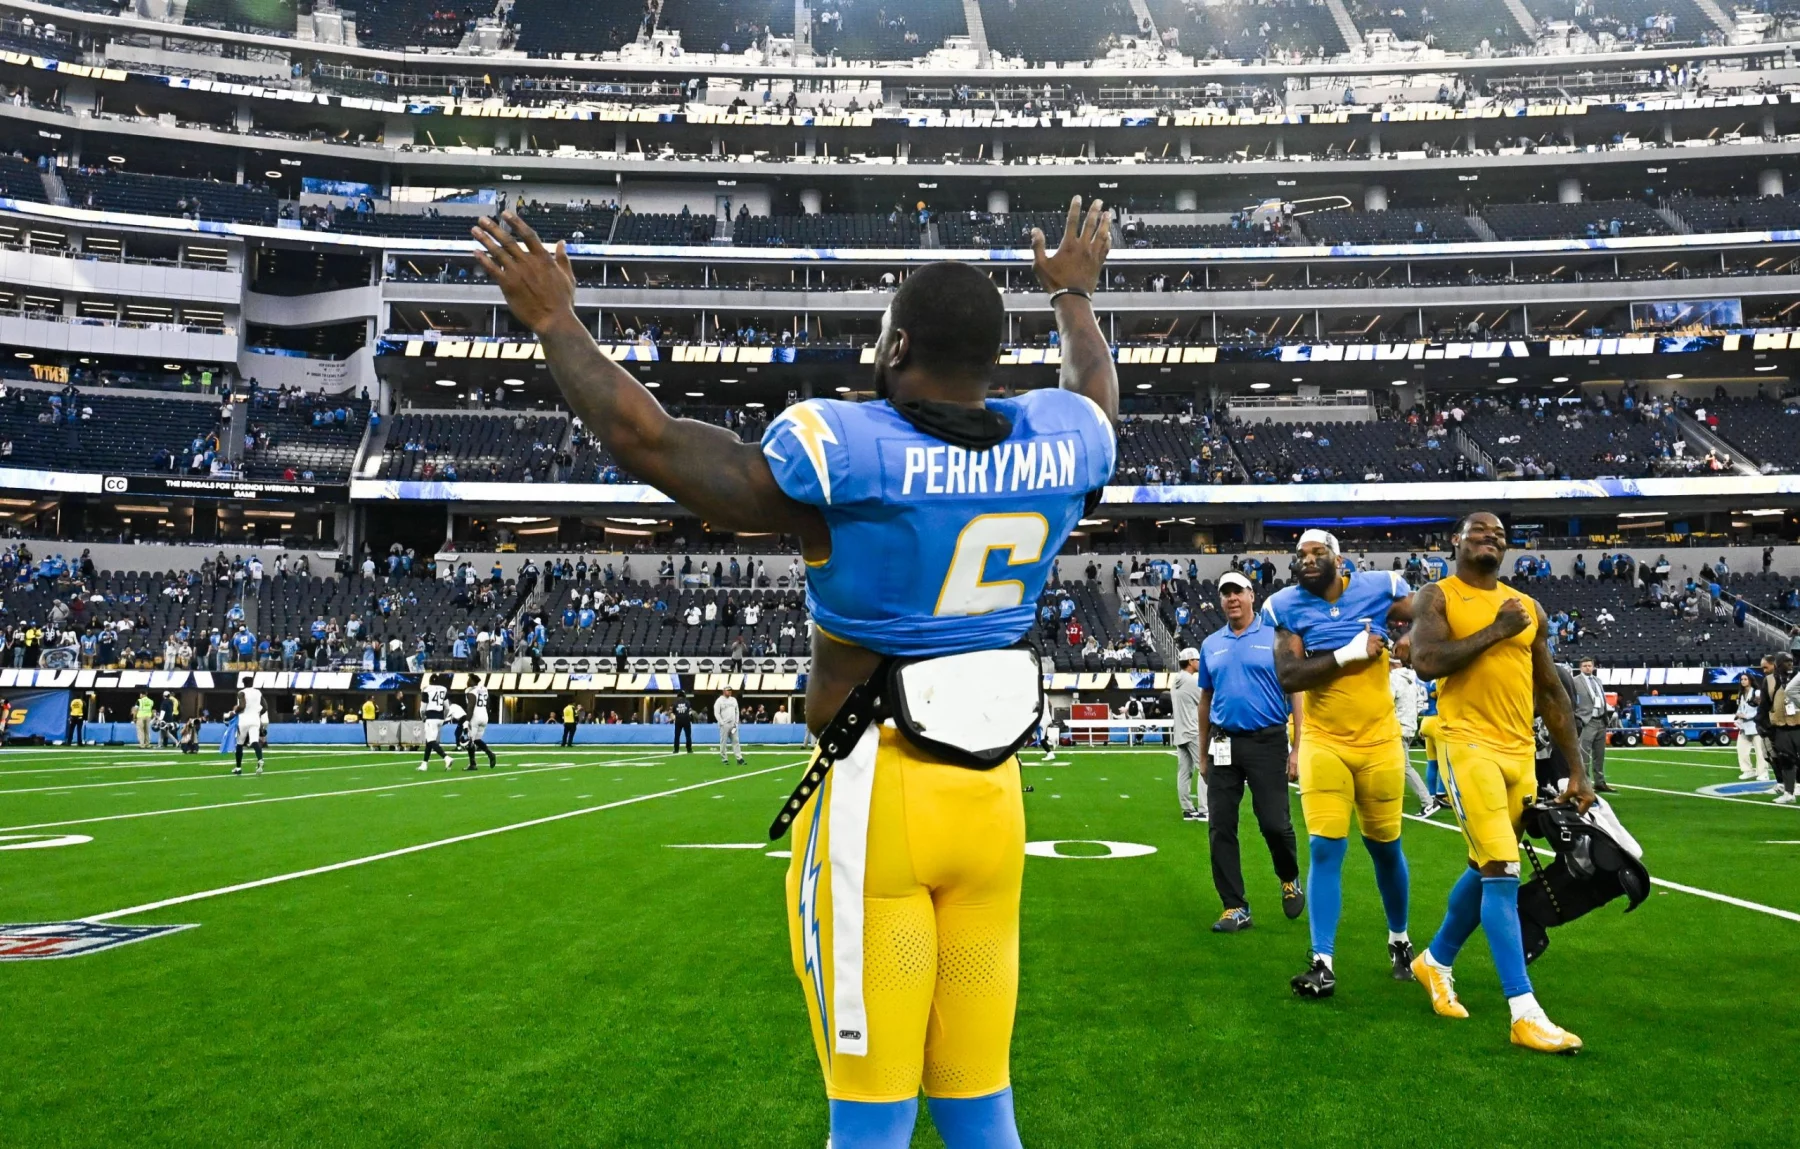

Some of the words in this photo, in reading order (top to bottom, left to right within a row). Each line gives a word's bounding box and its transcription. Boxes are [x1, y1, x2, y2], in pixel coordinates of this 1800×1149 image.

[902, 439, 1077, 496] PERRYMAN
[165, 479, 181, 488] THE
[181, 480, 215, 489] BENGALS
[215, 482, 230, 490] FOR
[231, 483, 264, 492] LEGENDS
[300, 485, 315, 494] THE
[234, 490, 257, 498] GAME
[933, 512, 1049, 617] 6
[432, 691, 445, 706] 49
